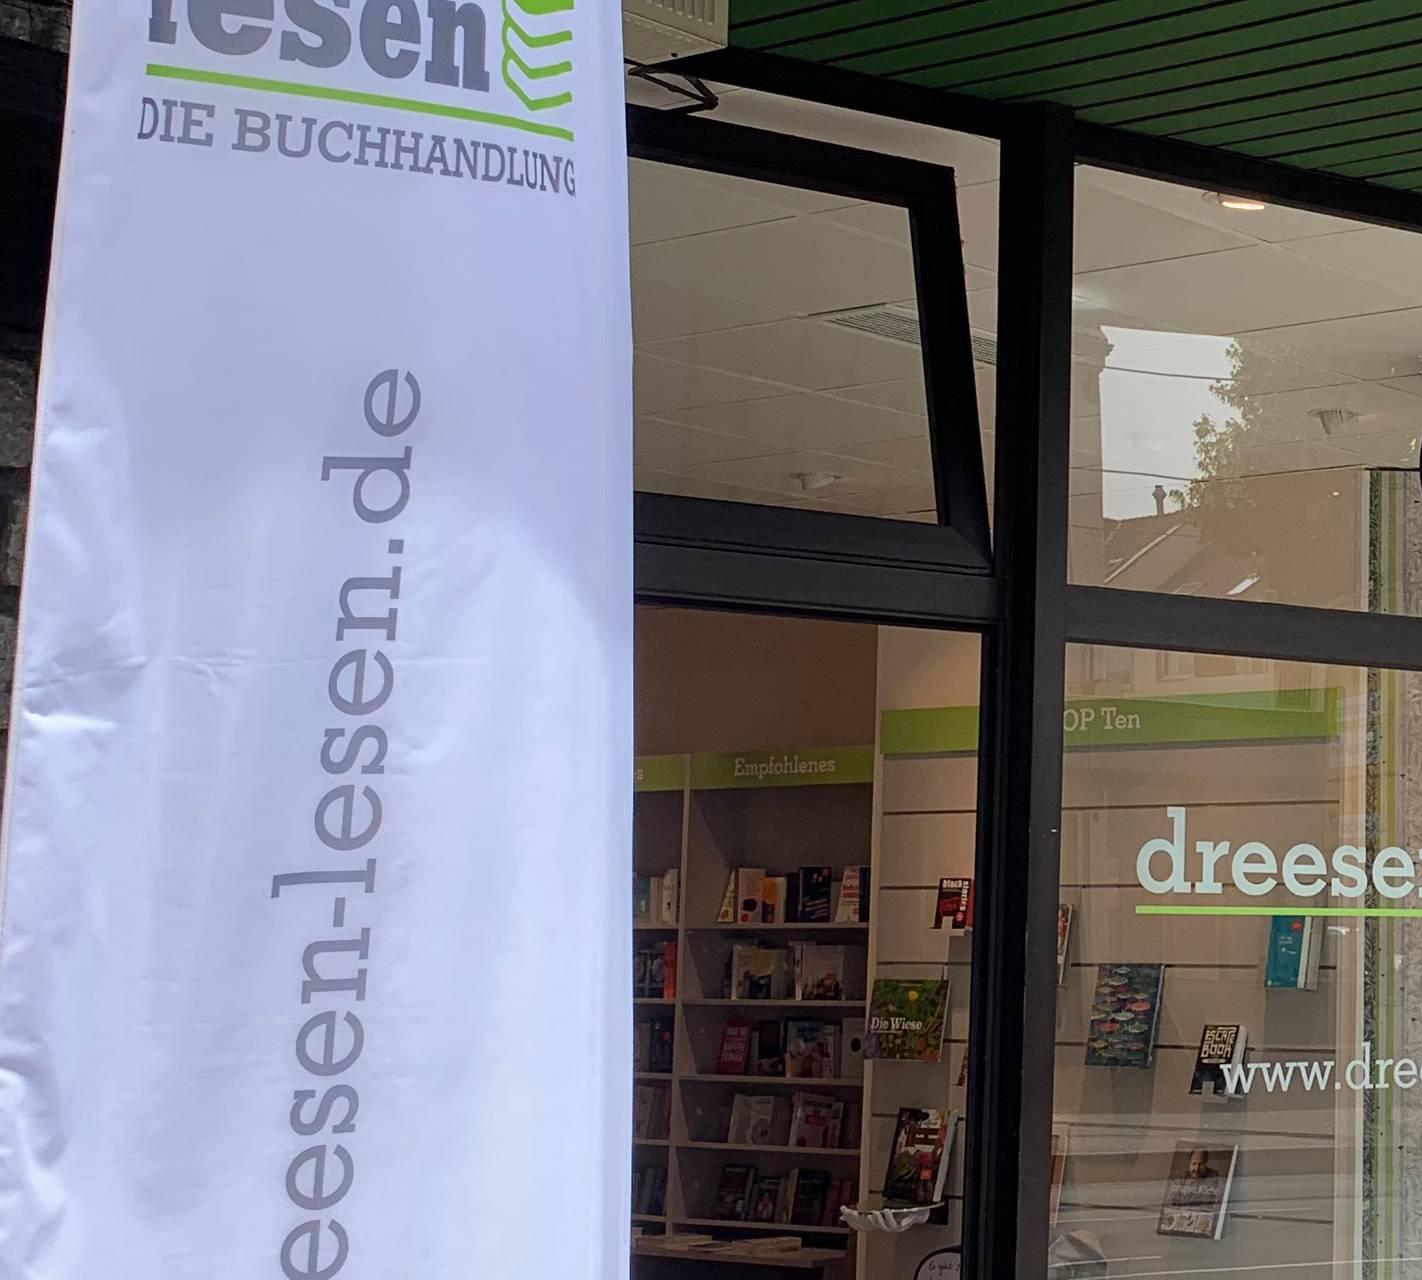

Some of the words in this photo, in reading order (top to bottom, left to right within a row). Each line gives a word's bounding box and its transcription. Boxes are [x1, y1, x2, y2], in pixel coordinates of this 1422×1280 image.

[137, 97, 216, 147] DIE
[231, 108, 577, 198] BUCHHANDLUNG
[1101, 706, 1141, 730] Ten
[734, 755, 836, 779] Empfohlenes
[870, 1016, 889, 1030] Die
[890, 1017, 923, 1031] Wiese
